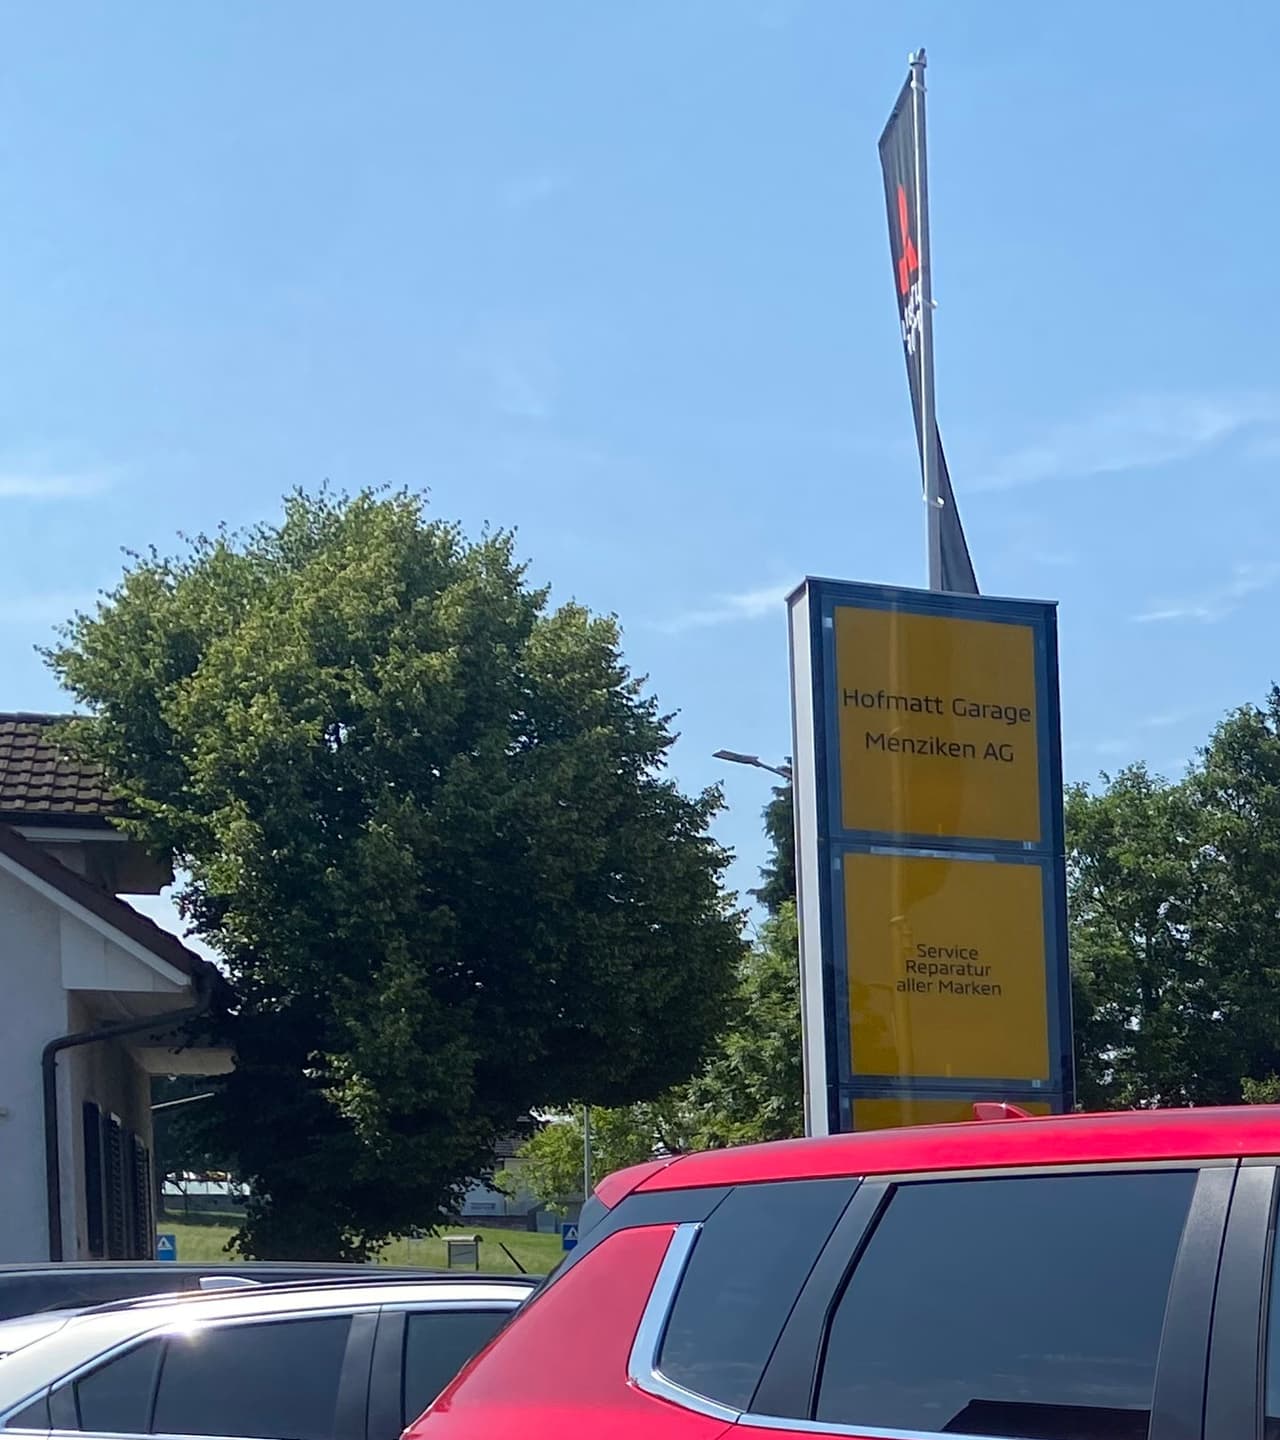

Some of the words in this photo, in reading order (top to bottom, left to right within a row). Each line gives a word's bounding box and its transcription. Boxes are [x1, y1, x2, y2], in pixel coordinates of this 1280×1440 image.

[843, 688, 944, 715] Hofmatt
[952, 698, 1032, 725] Garage
[865, 731, 976, 759] Menziken
[983, 742, 1014, 762] AG
[916, 943, 978, 960] Service
[905, 960, 992, 977] Reparatur
[896, 978, 933, 993] aller
[939, 980, 1002, 996] Marken
